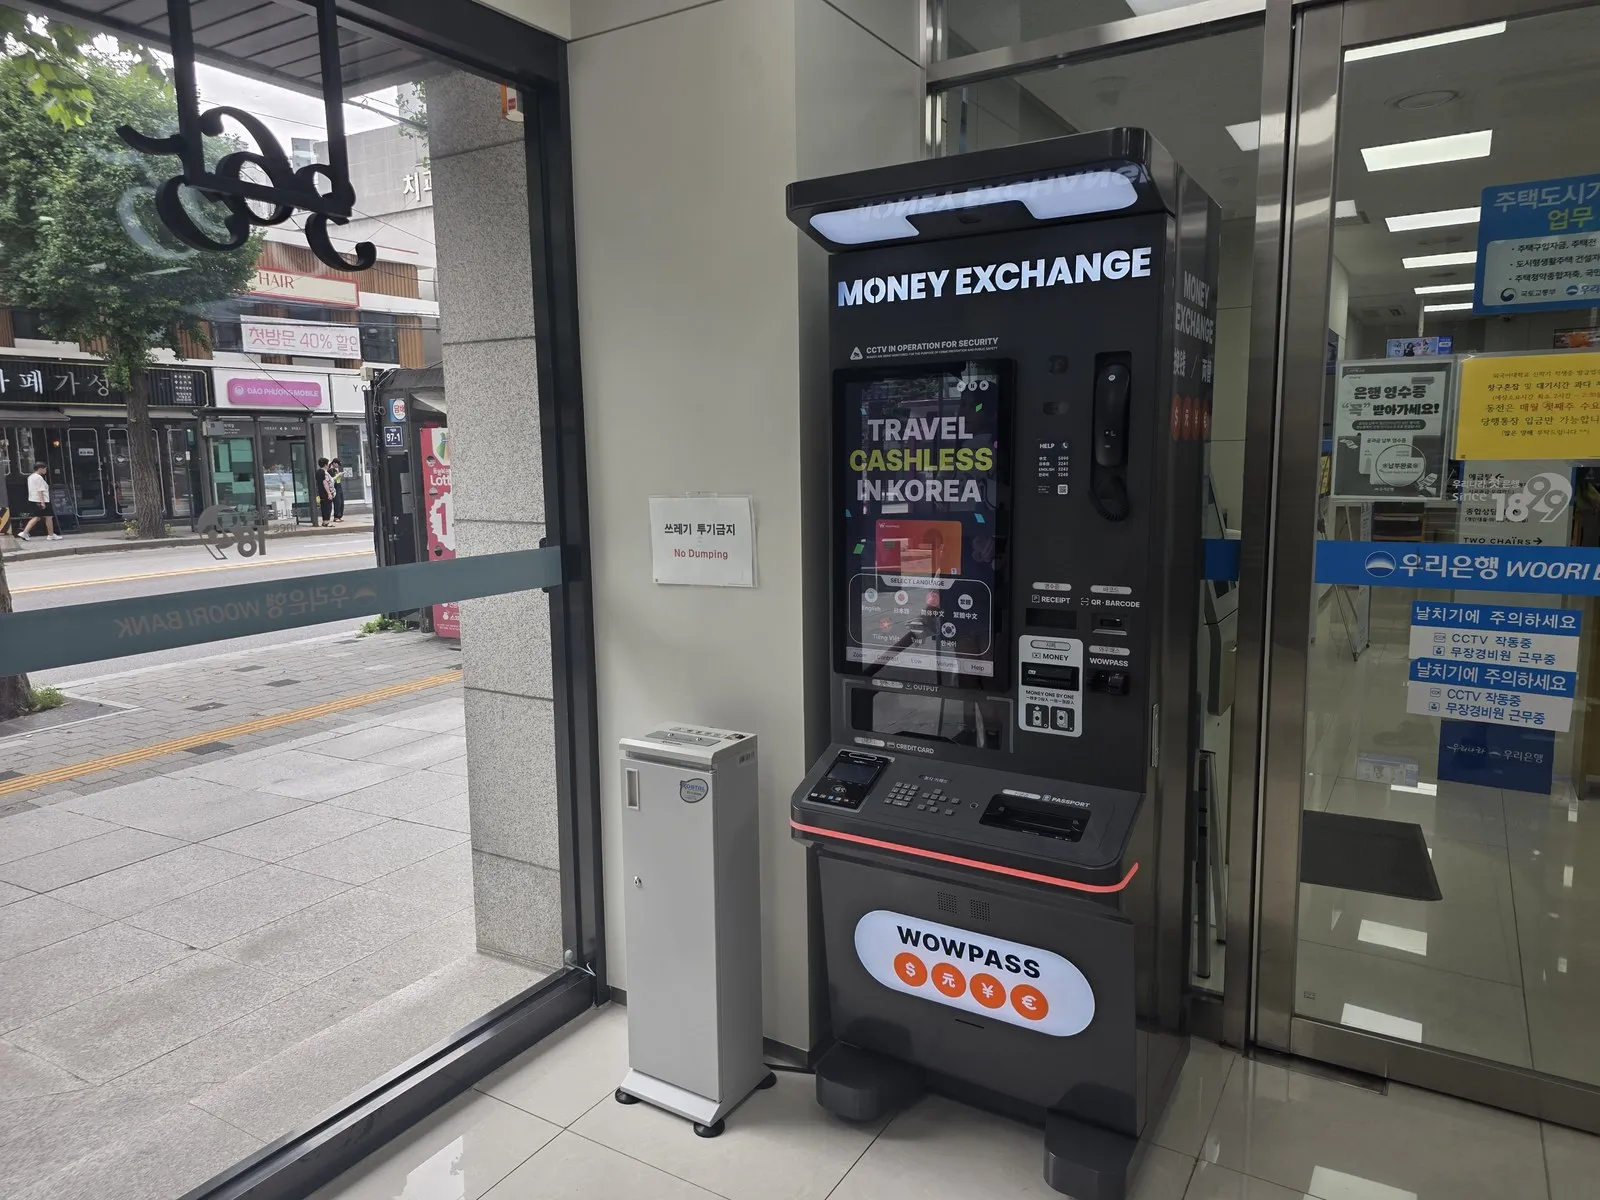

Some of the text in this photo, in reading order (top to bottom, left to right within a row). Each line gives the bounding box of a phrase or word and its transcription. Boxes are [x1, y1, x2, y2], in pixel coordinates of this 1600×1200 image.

[1547, 205, 1594, 231] 업무
[258, 271, 295, 289] HAIR
[837, 246, 1152, 307] MONEY EXCHANGE
[1183, 270, 1210, 310] MONEY
[1175, 302, 1214, 345] EXCHANGE
[248, 326, 358, 352] 첫방문 40% 할인
[866, 337, 999, 354] CCTV IN OPERATION FOR SECURITY
[0, 368, 43, 395] 페
[1536, 381, 1570, 390] 대기시간
[1574, 380, 1591, 389] 과다
[293, 389, 319, 397] MOBILE
[1353, 385, 1427, 400] 은행 영수증
[1373, 403, 1440, 416] 받아가세요!
[1487, 404, 1515, 413] 동전은
[1520, 403, 1539, 412] 매월
[1481, 414, 1600, 427] 당행통장 입금만 가능합니
[867, 416, 973, 441] TRAVEL
[386, 432, 401, 442] 97-1
[850, 447, 993, 472] CASHLESS
[430, 474, 452, 486] Lott
[857, 479, 982, 502] IN KOREA
[1452, 473, 1572, 523] Since 1899
[1466, 508, 1506, 516] 종합상담
[664, 523, 736, 536] 쓰레기 투기금지
[674, 548, 728, 560] No Dumping
[1399, 553, 1499, 580] 우리은행
[1506, 560, 1589, 581] WOORI
[890, 577, 945, 587] SELECT LANGUAGE
[1041, 596, 1071, 604] RECEIPT
[1416, 606, 1577, 629] 날치기에 주의하세요
[1451, 633, 1532, 649] CCTV 작동중
[1042, 653, 1069, 662] MONEY
[1089, 657, 1129, 667] WOWPASS
[1450, 646, 1556, 666] 무장경비원 근무중
[971, 663, 985, 672] Help
[1416, 661, 1567, 691] 날치기에 주의하세요
[913, 684, 939, 693] OUTPUT
[1447, 688, 1521, 708] CCTV 작동중
[1445, 702, 1546, 725] 무장경비원 근무중
[896, 743, 934, 754] CREDIT CARD
[1503, 749, 1544, 764] 우리은행
[1051, 796, 1091, 809] PASSPORT
[896, 925, 1041, 979] WOWPASS
